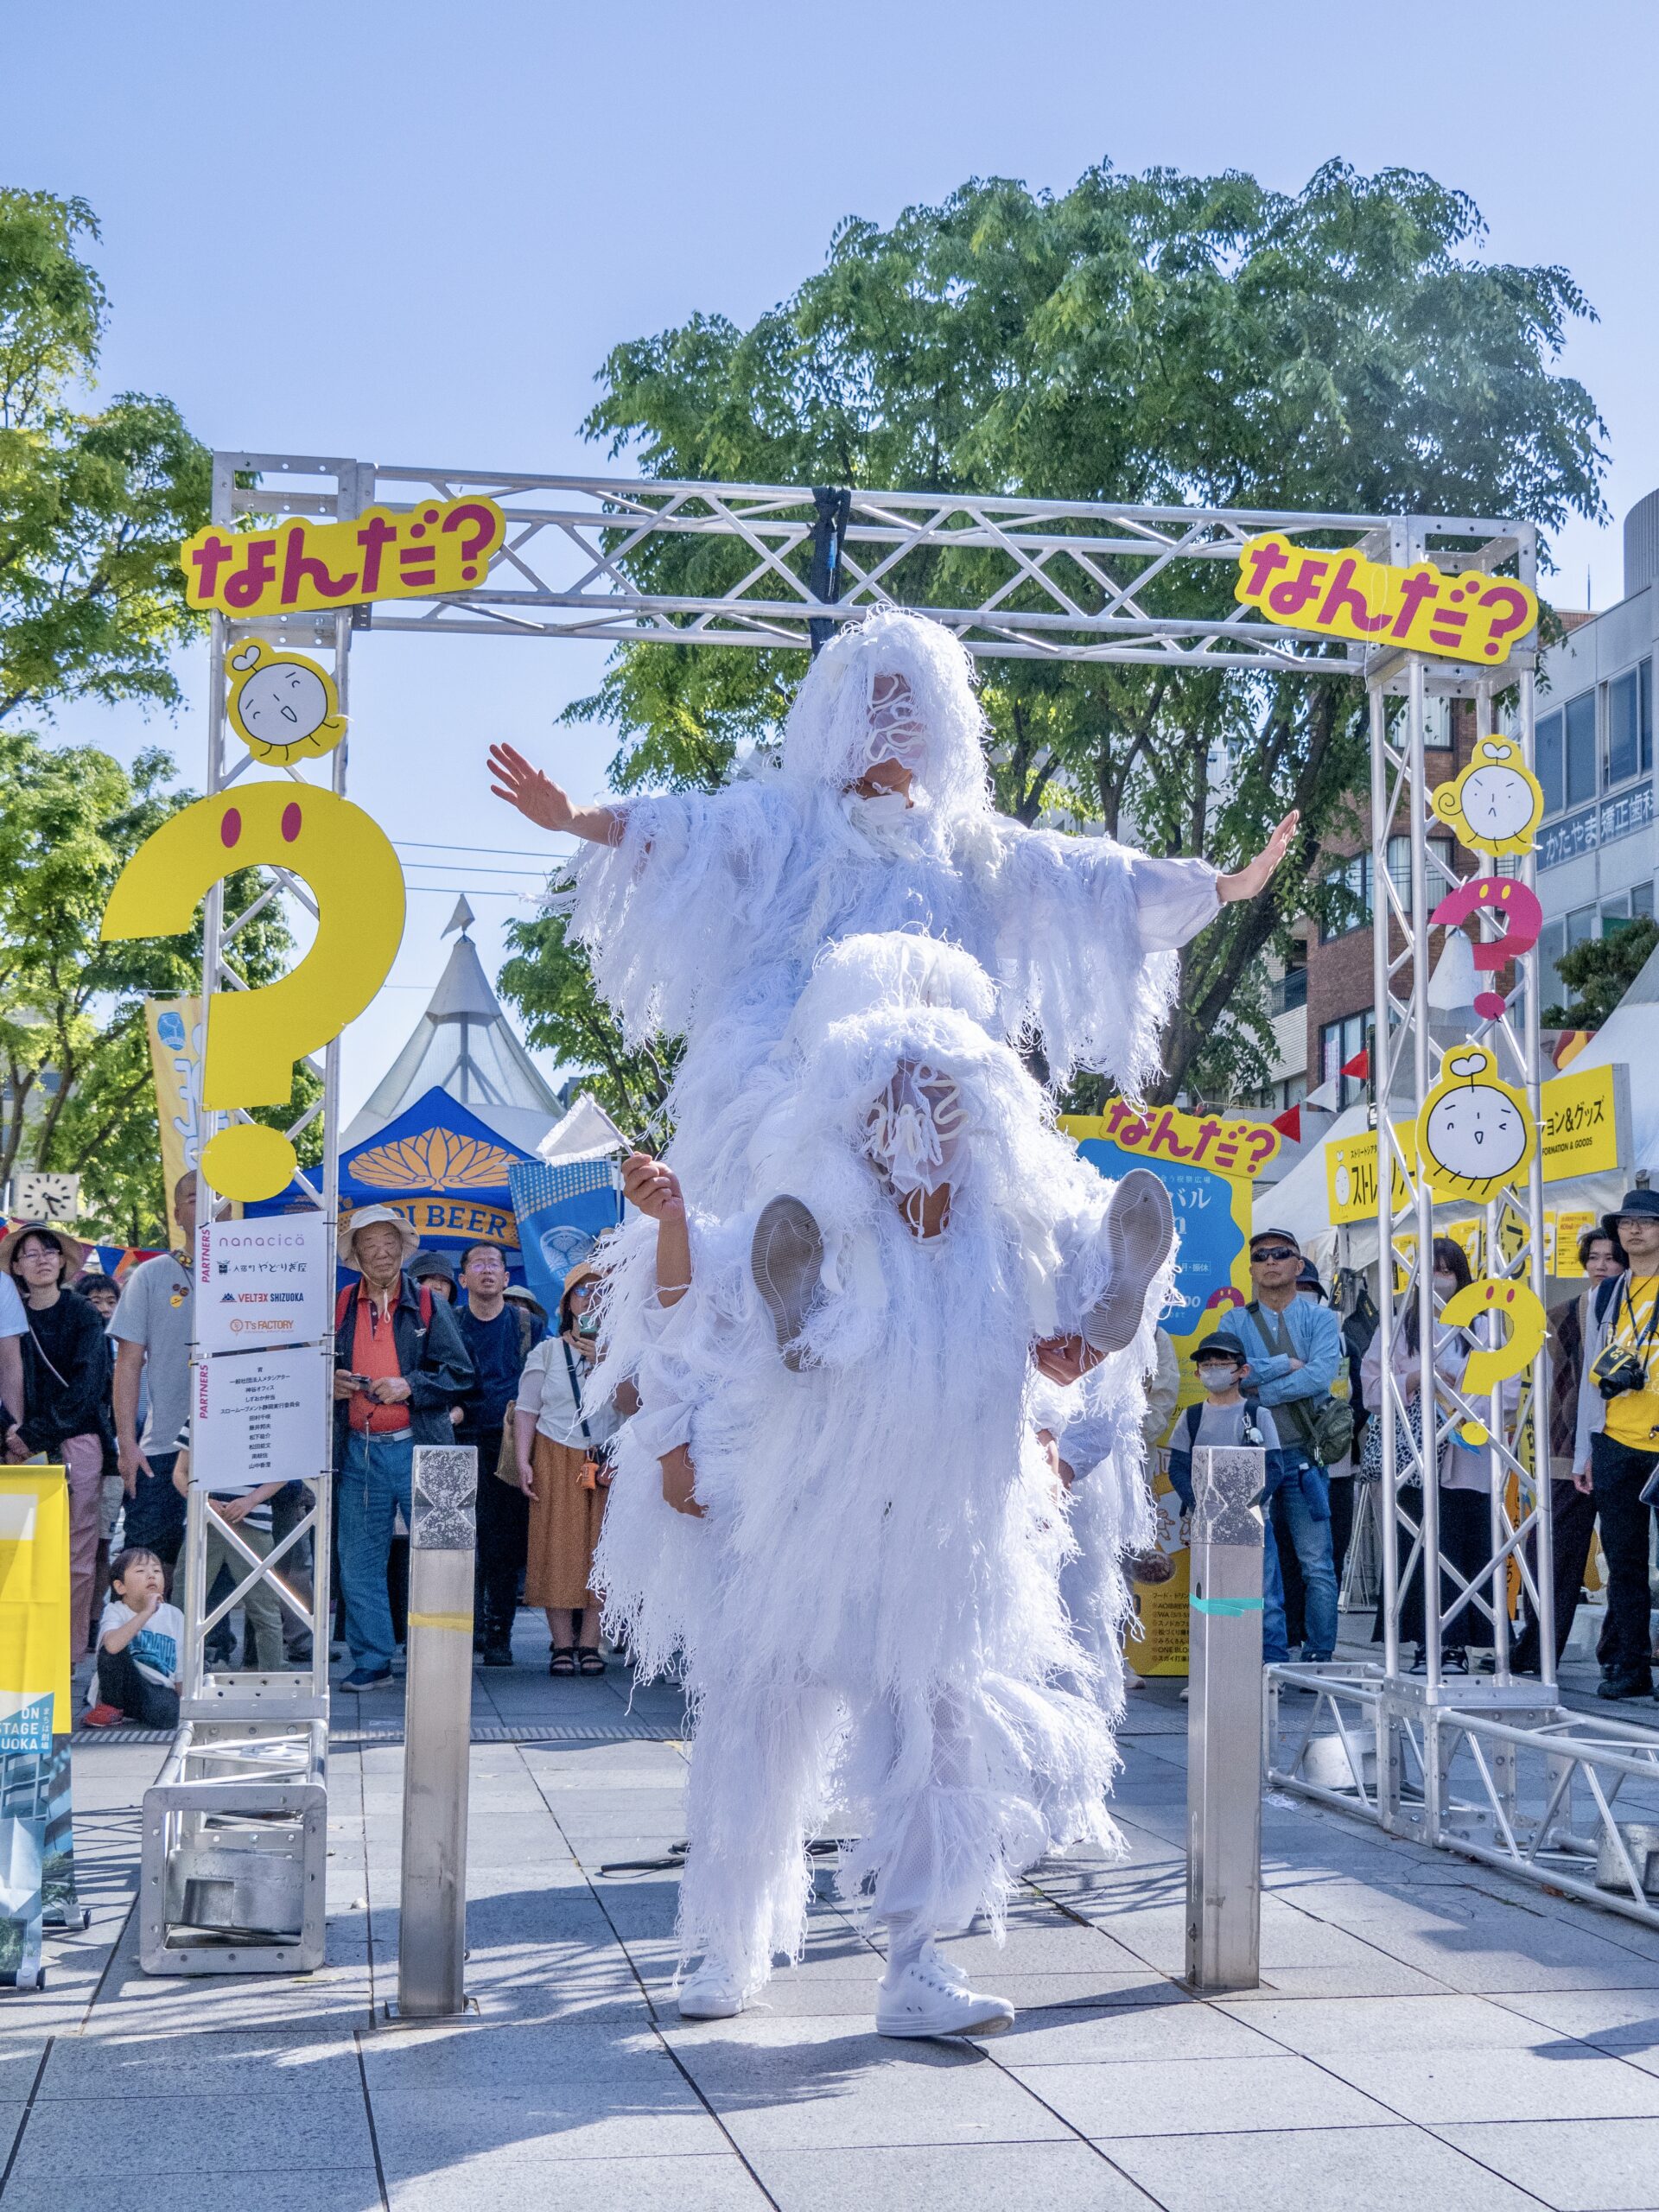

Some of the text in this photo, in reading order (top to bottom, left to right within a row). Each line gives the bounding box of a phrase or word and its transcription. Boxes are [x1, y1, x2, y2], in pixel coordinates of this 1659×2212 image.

[192, 503, 497, 609] なんだ?
[1245, 542, 1529, 657] なんだ?
[1106, 1101, 1275, 1174] なんだ?
[1574, 1136, 1593, 1148] GOODS
[426, 1205, 507, 1238] BEER
[201, 1228, 211, 1283] PARTNERS
[270, 1292, 304, 1302] SHIZUOKA
[257, 1319, 295, 1330] FACTORY
[200, 1364, 208, 1420] PARTNERS
[21, 1707, 40, 1719] ON
[0, 1722, 40, 1735] TAGE
[1, 1738, 38, 1750] UOKA
